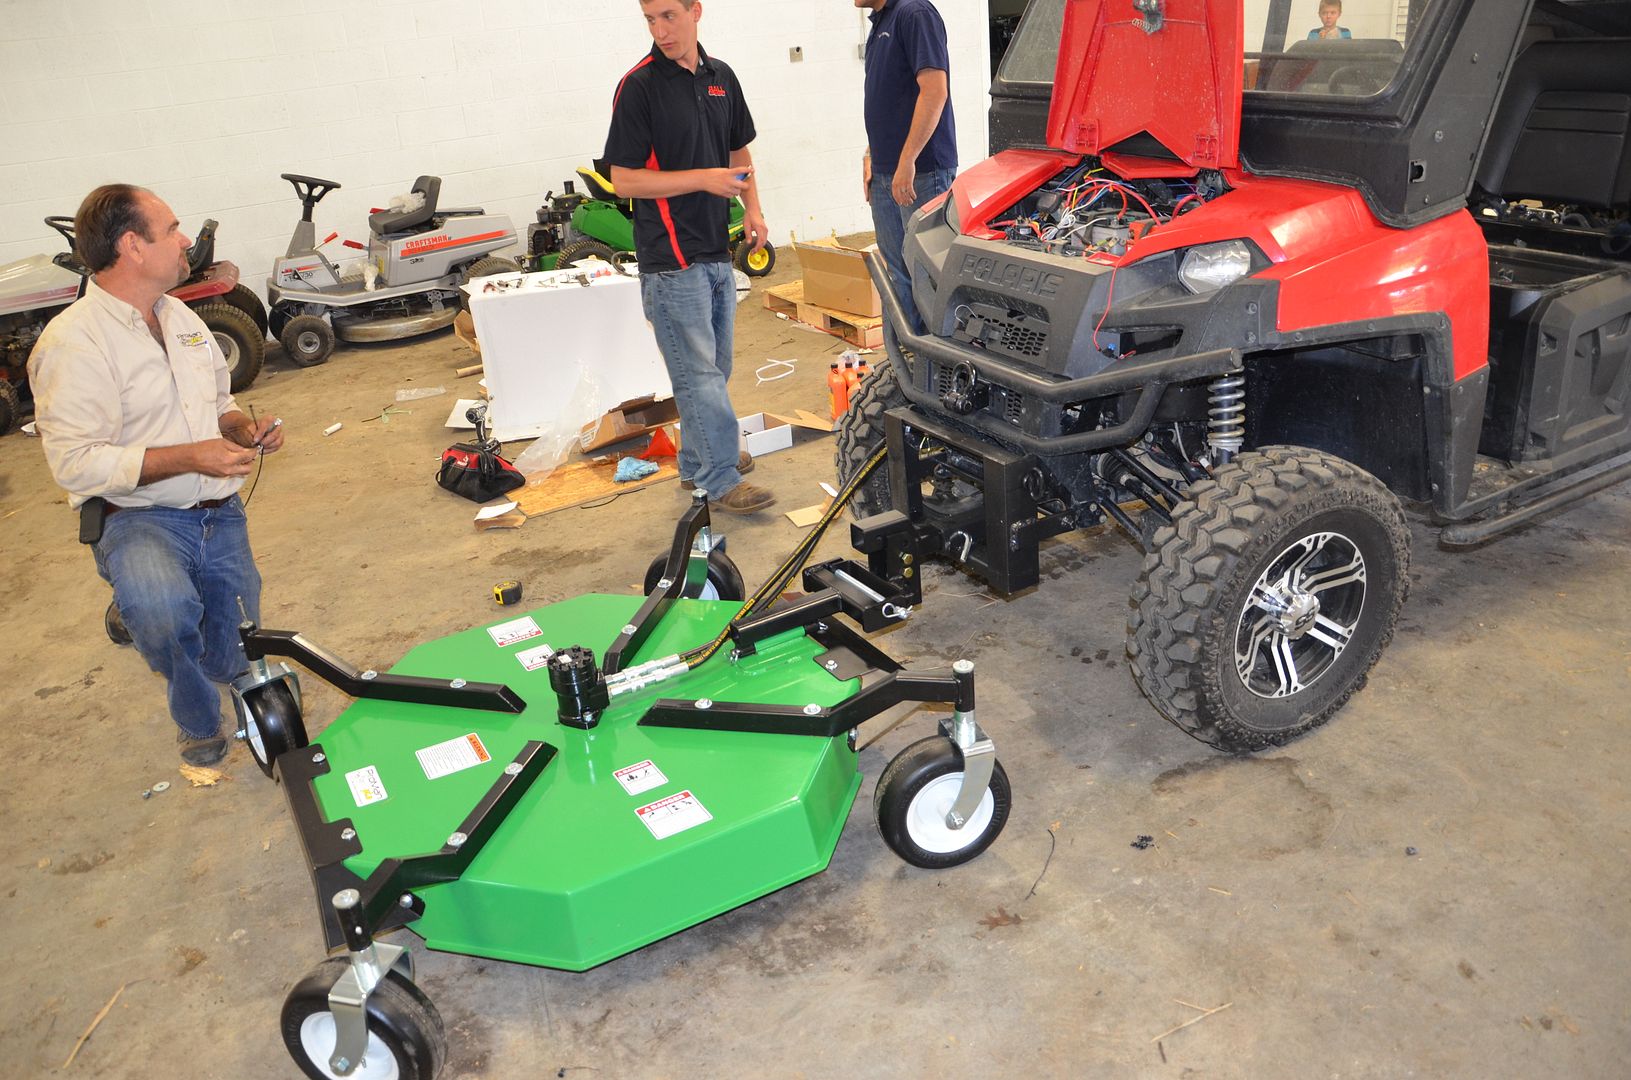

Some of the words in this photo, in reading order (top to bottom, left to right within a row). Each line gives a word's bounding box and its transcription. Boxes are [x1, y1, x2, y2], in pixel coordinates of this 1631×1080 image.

[405, 234, 448, 249] CRAFTSMAN
[960, 253, 1065, 300] POLARIS
[649, 794, 685, 810] DANGER
